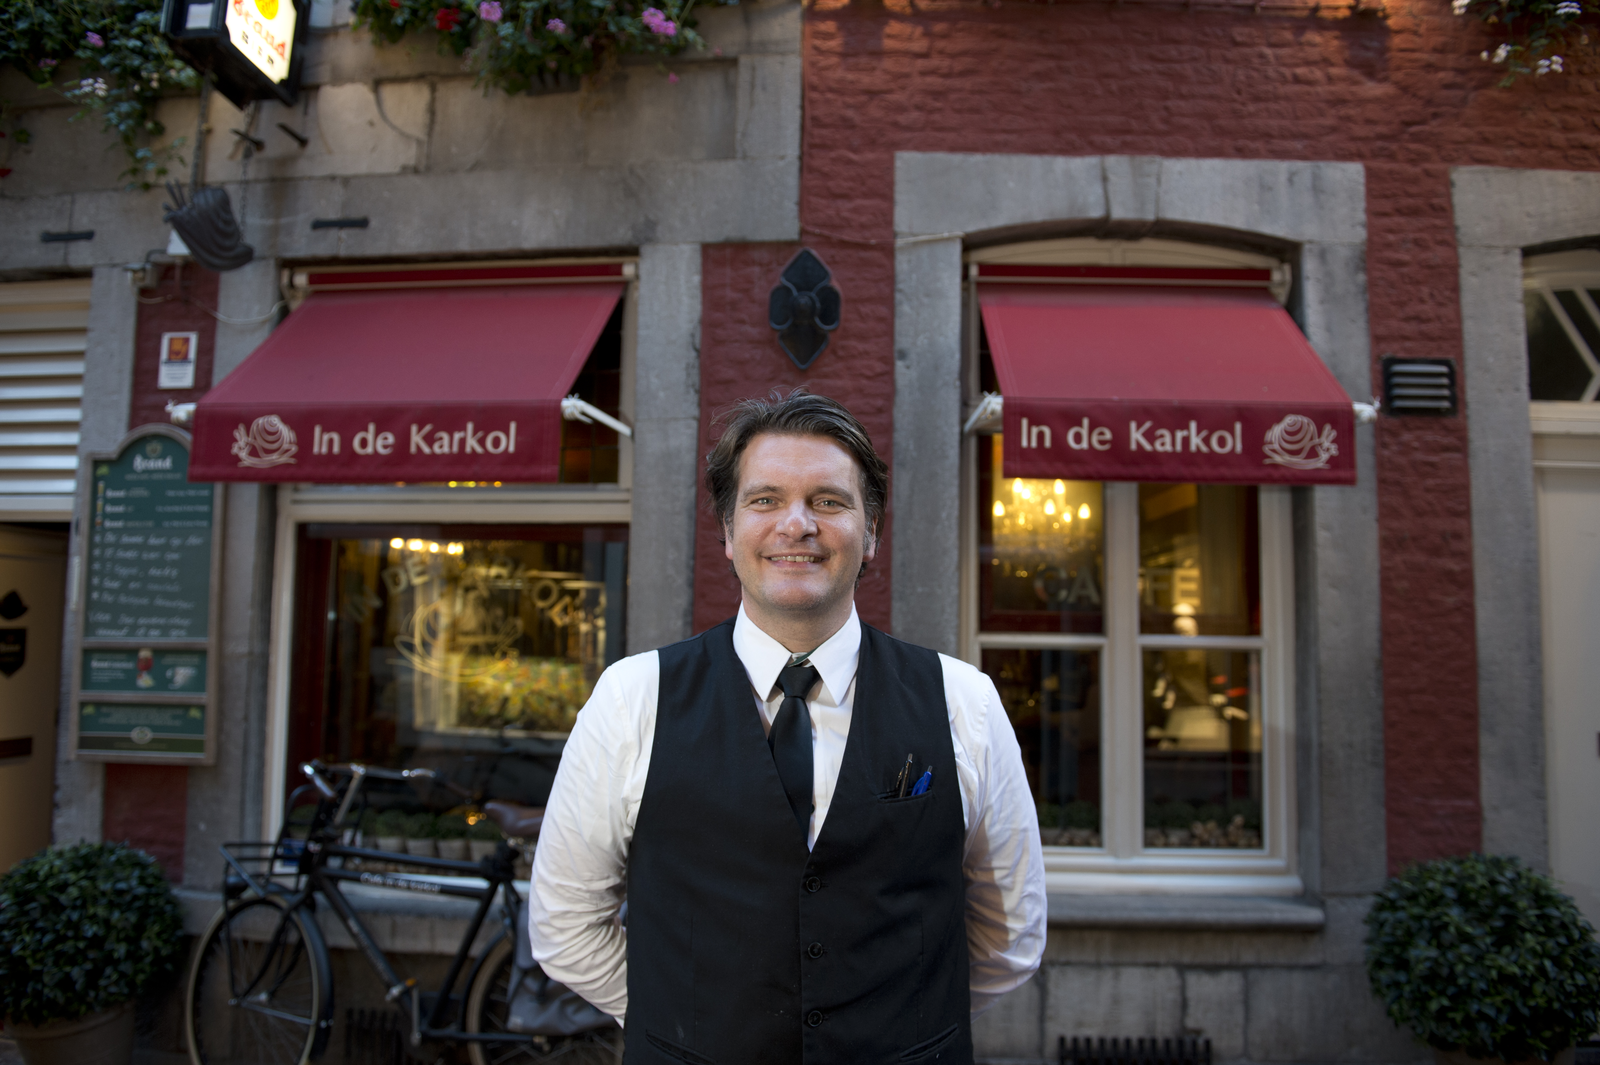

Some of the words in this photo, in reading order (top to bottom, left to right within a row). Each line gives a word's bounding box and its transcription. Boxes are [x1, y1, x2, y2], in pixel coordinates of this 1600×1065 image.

[312, 424, 342, 455] In
[352, 422, 396, 455] de
[409, 420, 518, 455] Karkol
[1020, 417, 1052, 449] In
[1066, 416, 1113, 451] de
[1129, 419, 1243, 455] Karkol
